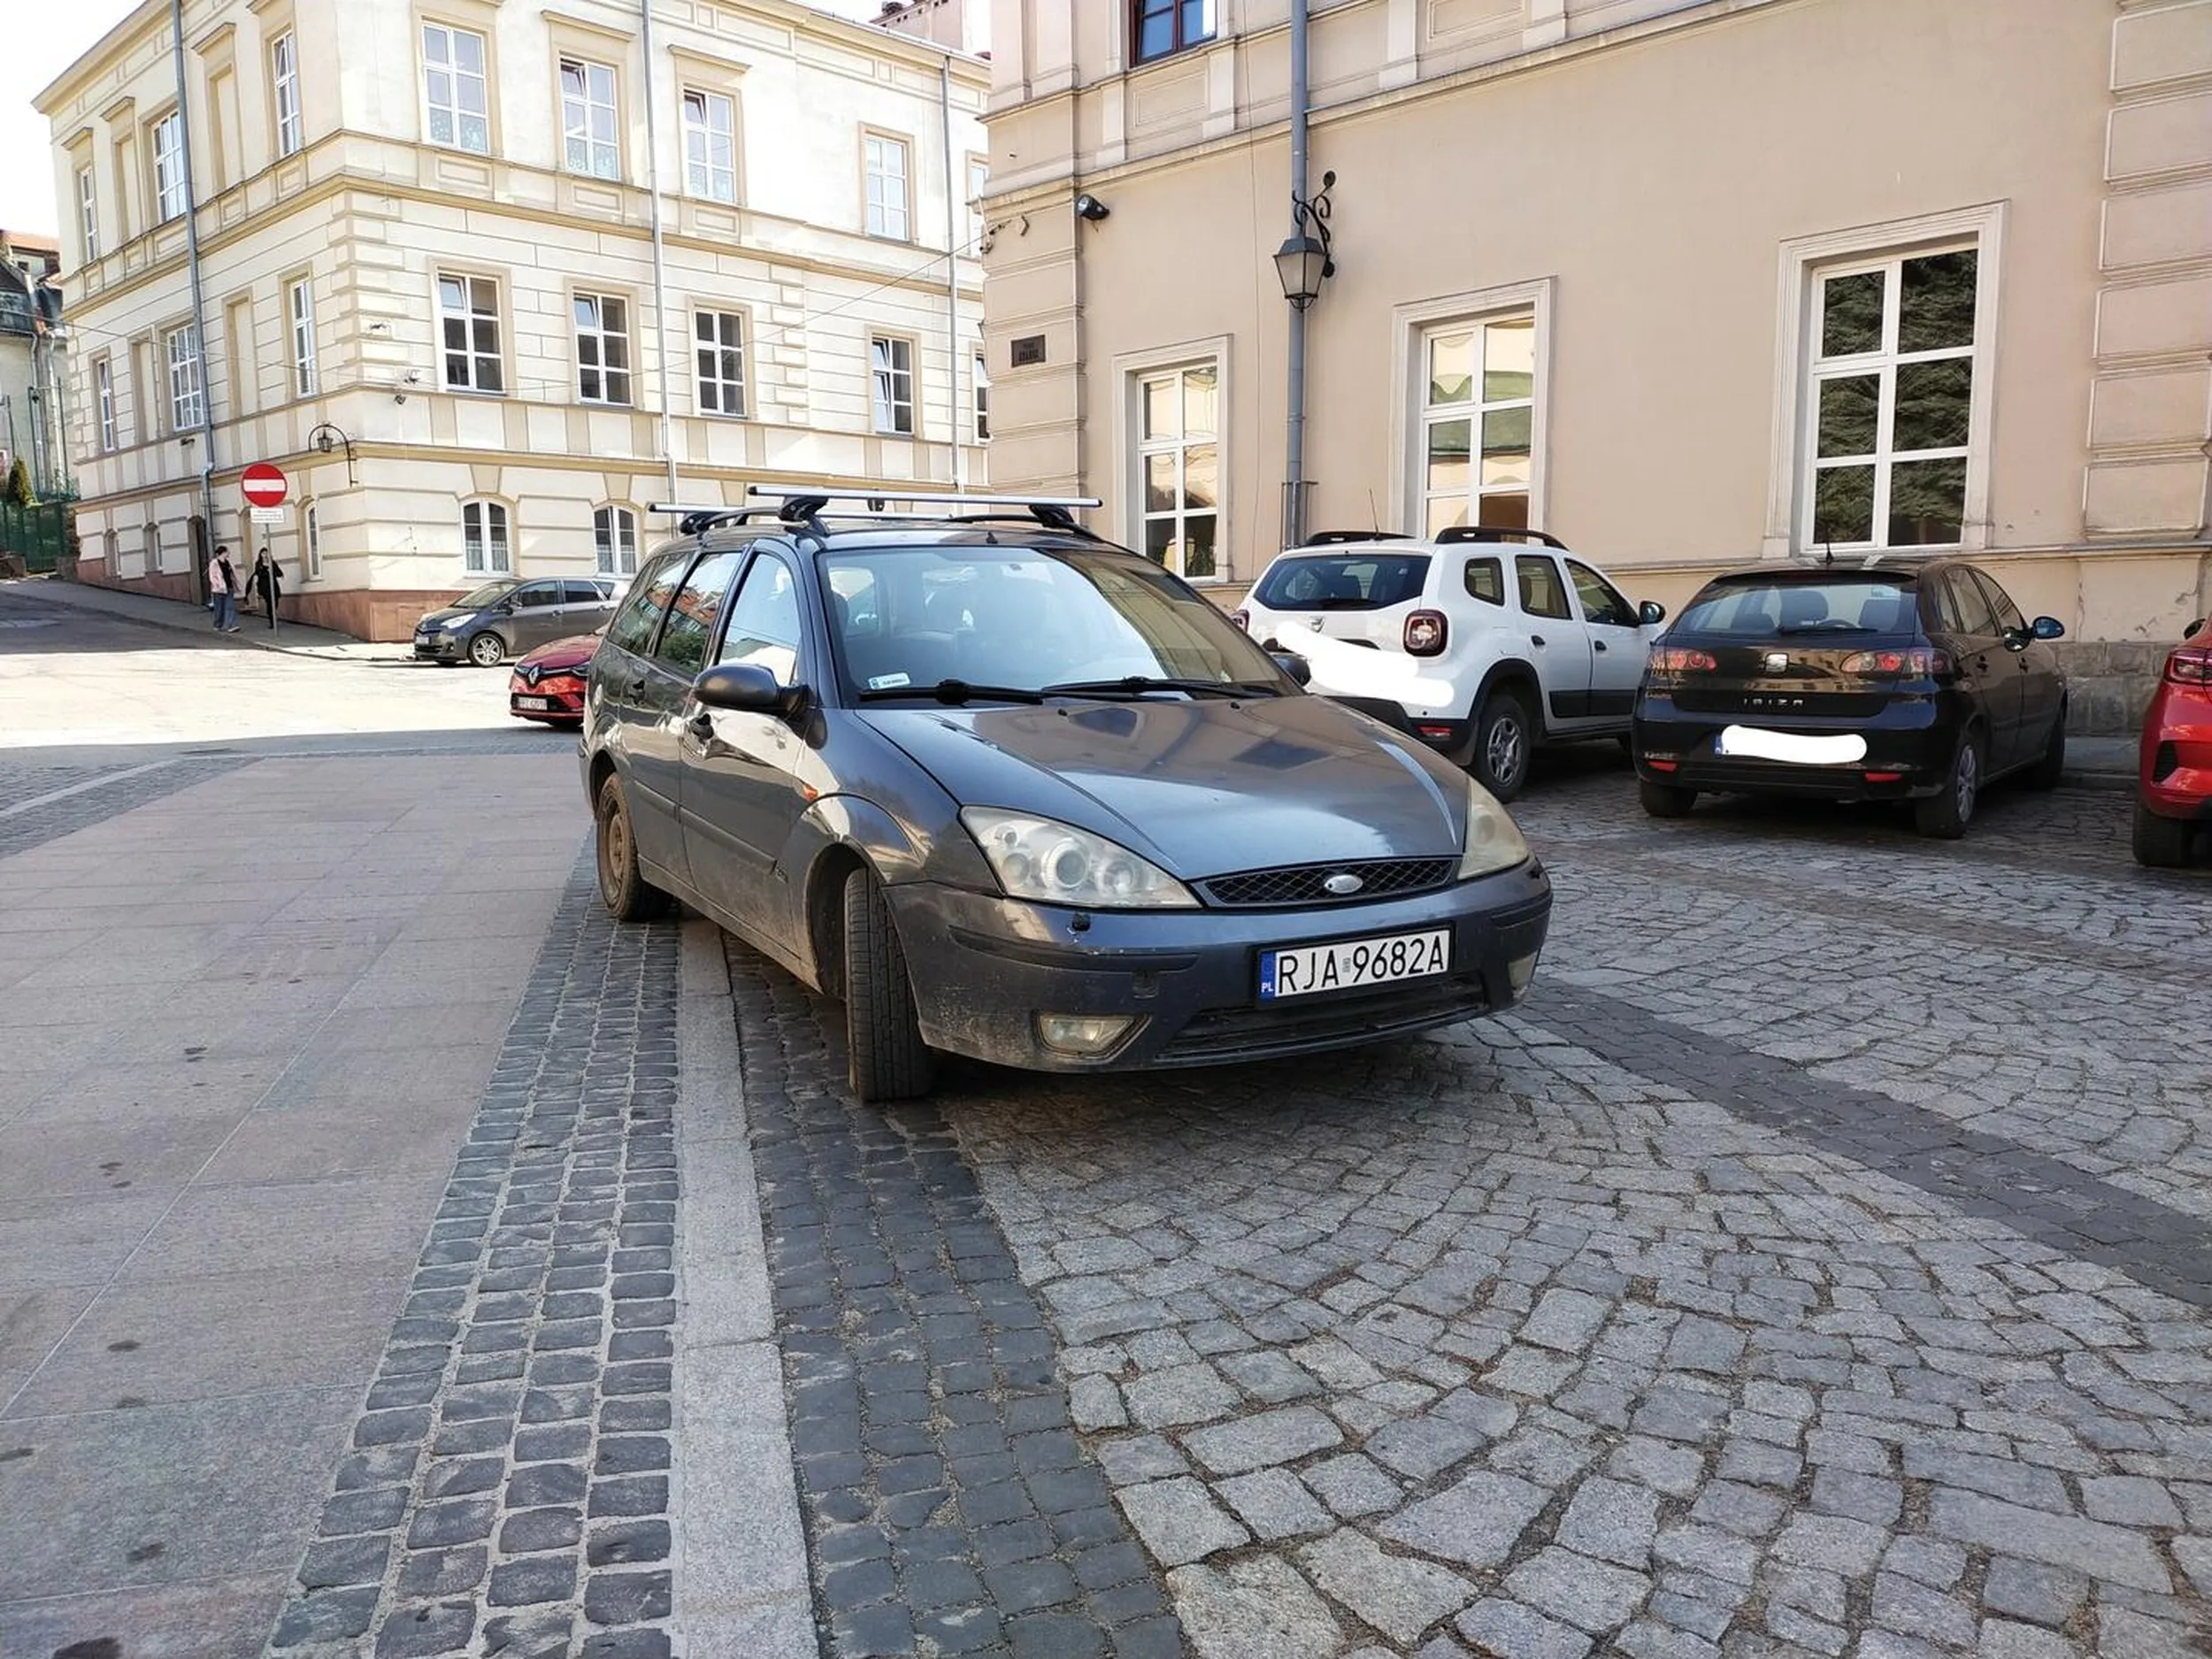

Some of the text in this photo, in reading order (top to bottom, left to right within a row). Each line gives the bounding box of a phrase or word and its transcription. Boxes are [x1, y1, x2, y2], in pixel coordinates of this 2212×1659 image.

[1743, 697, 1804, 707] IBIZA
[1279, 935, 1444, 994] RJA 9682A
[1261, 981, 1274, 993] PL
